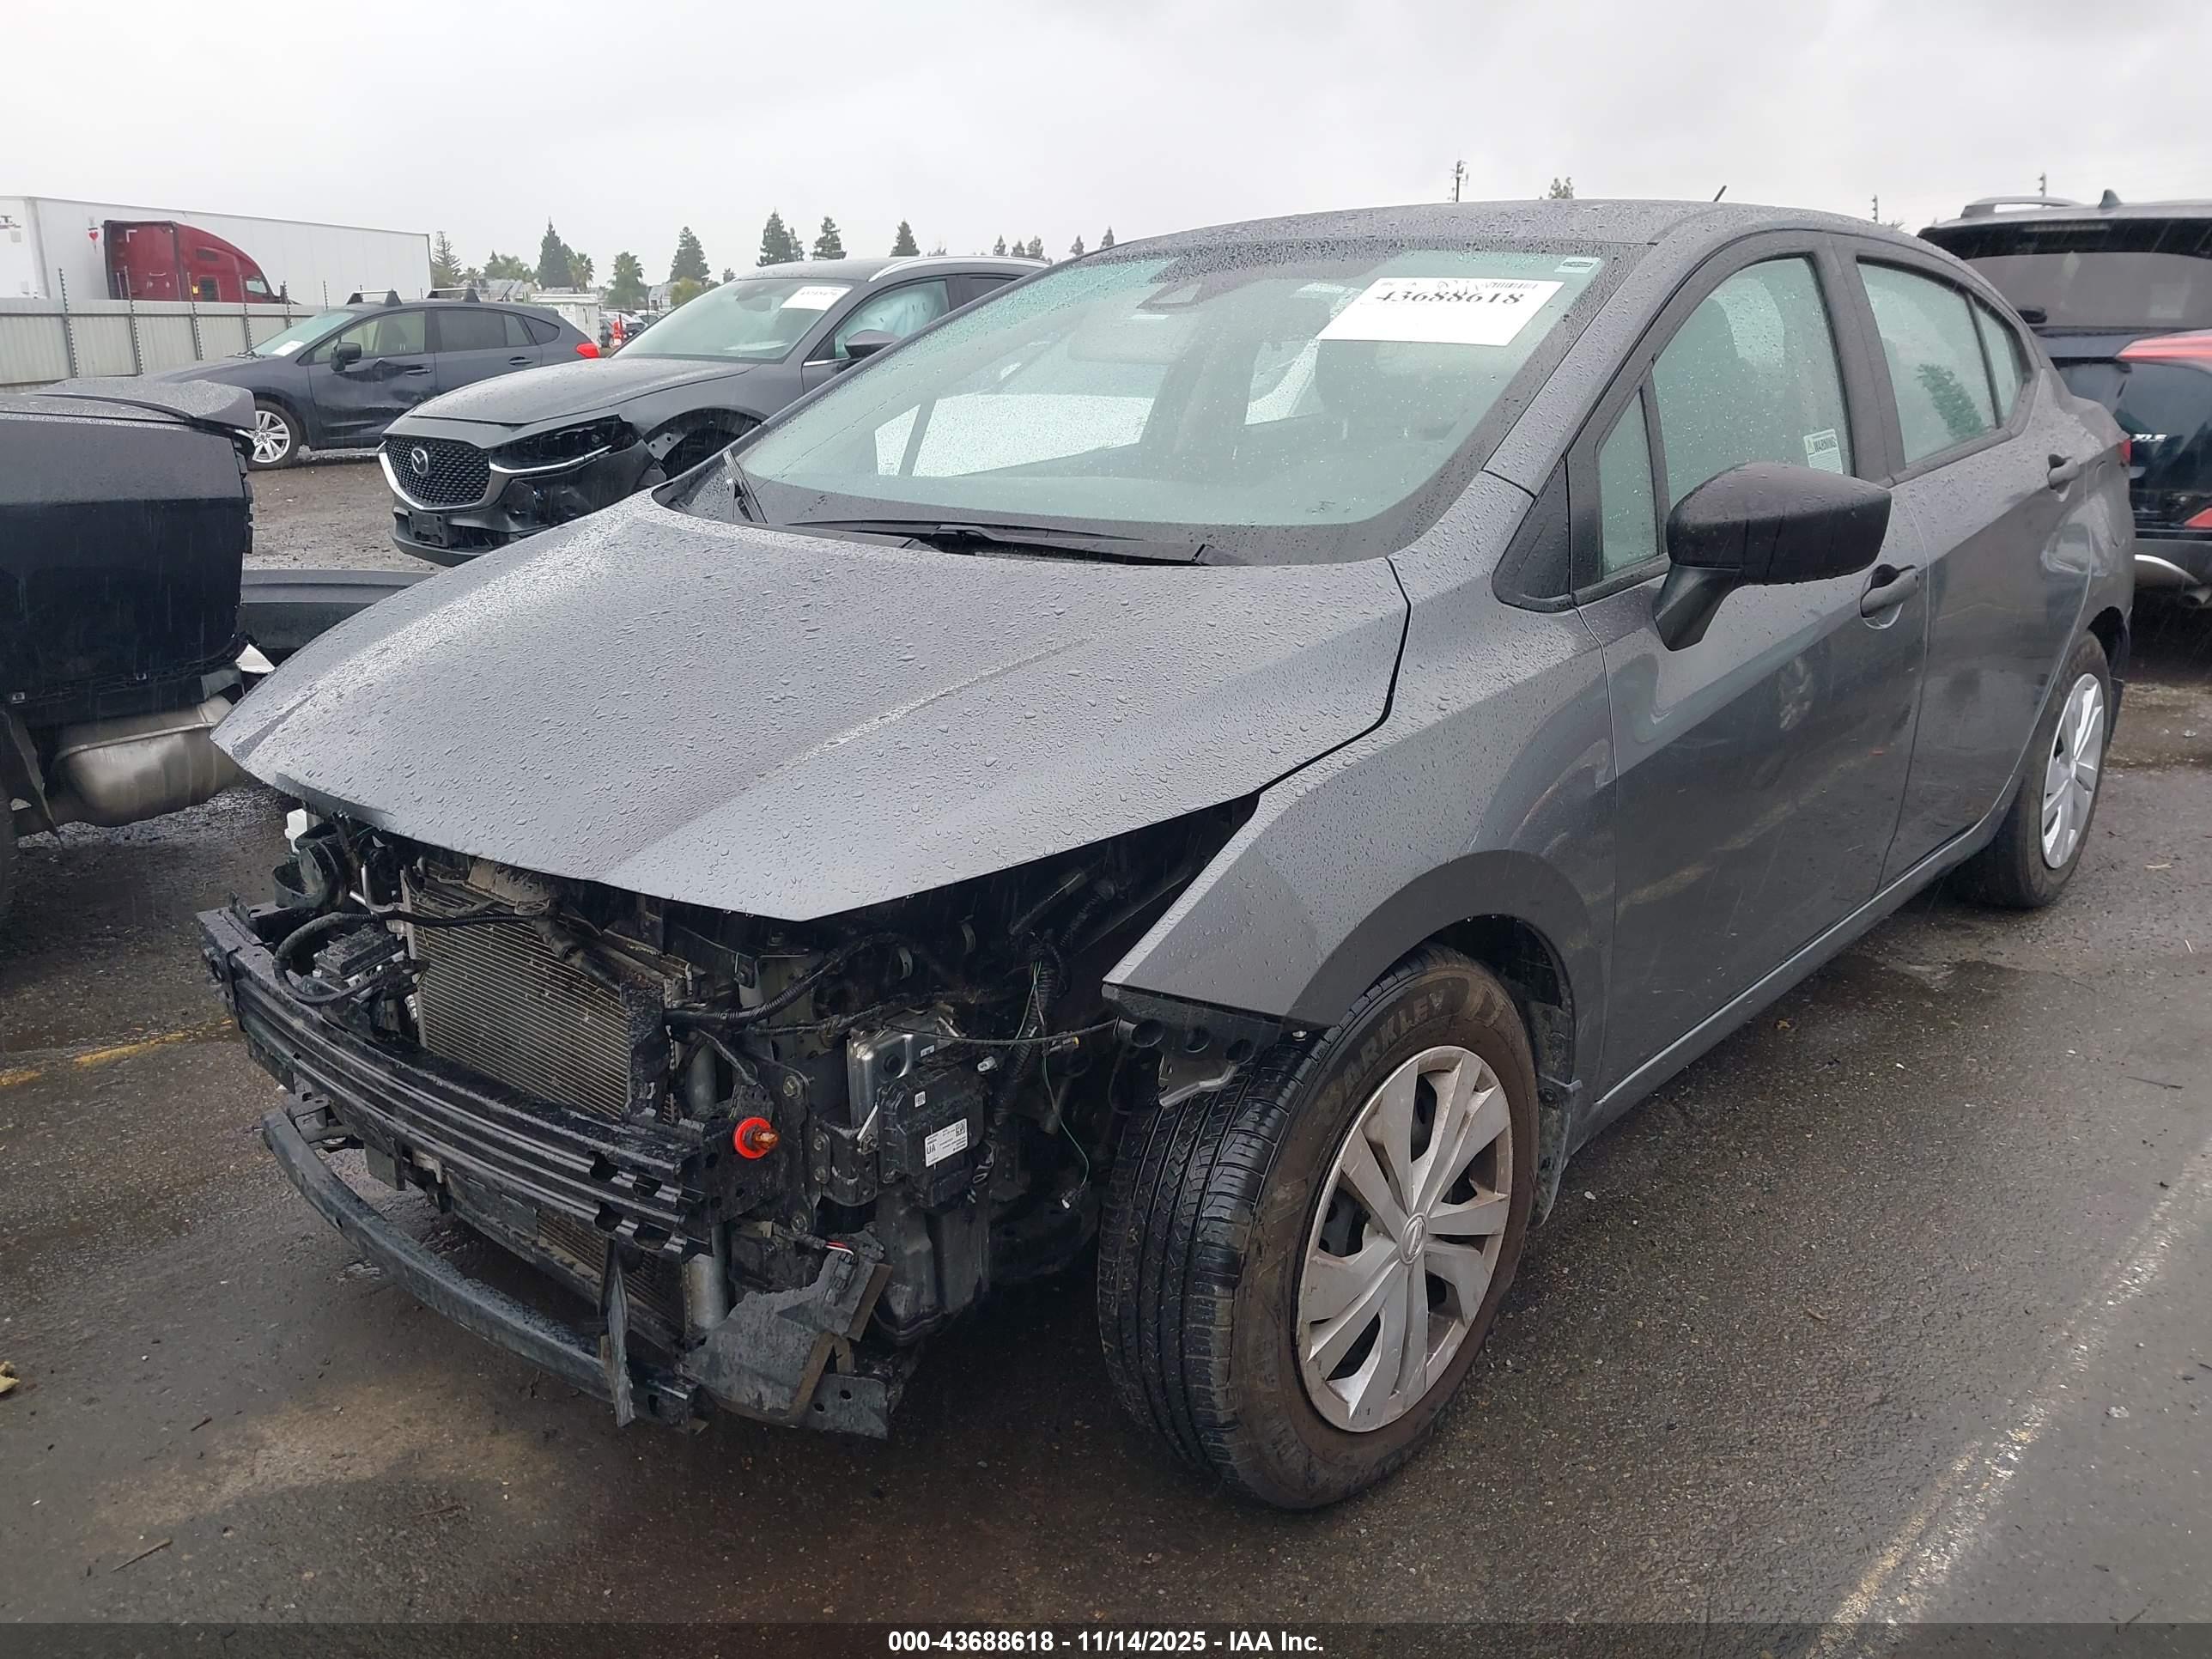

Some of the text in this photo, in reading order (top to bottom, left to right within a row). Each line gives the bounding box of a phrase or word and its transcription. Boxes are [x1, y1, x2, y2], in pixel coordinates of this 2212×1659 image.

[1376, 290, 1524, 304] 43688618
[2131, 434, 2167, 442] XLE
[927, 1143, 936, 1155] UA
